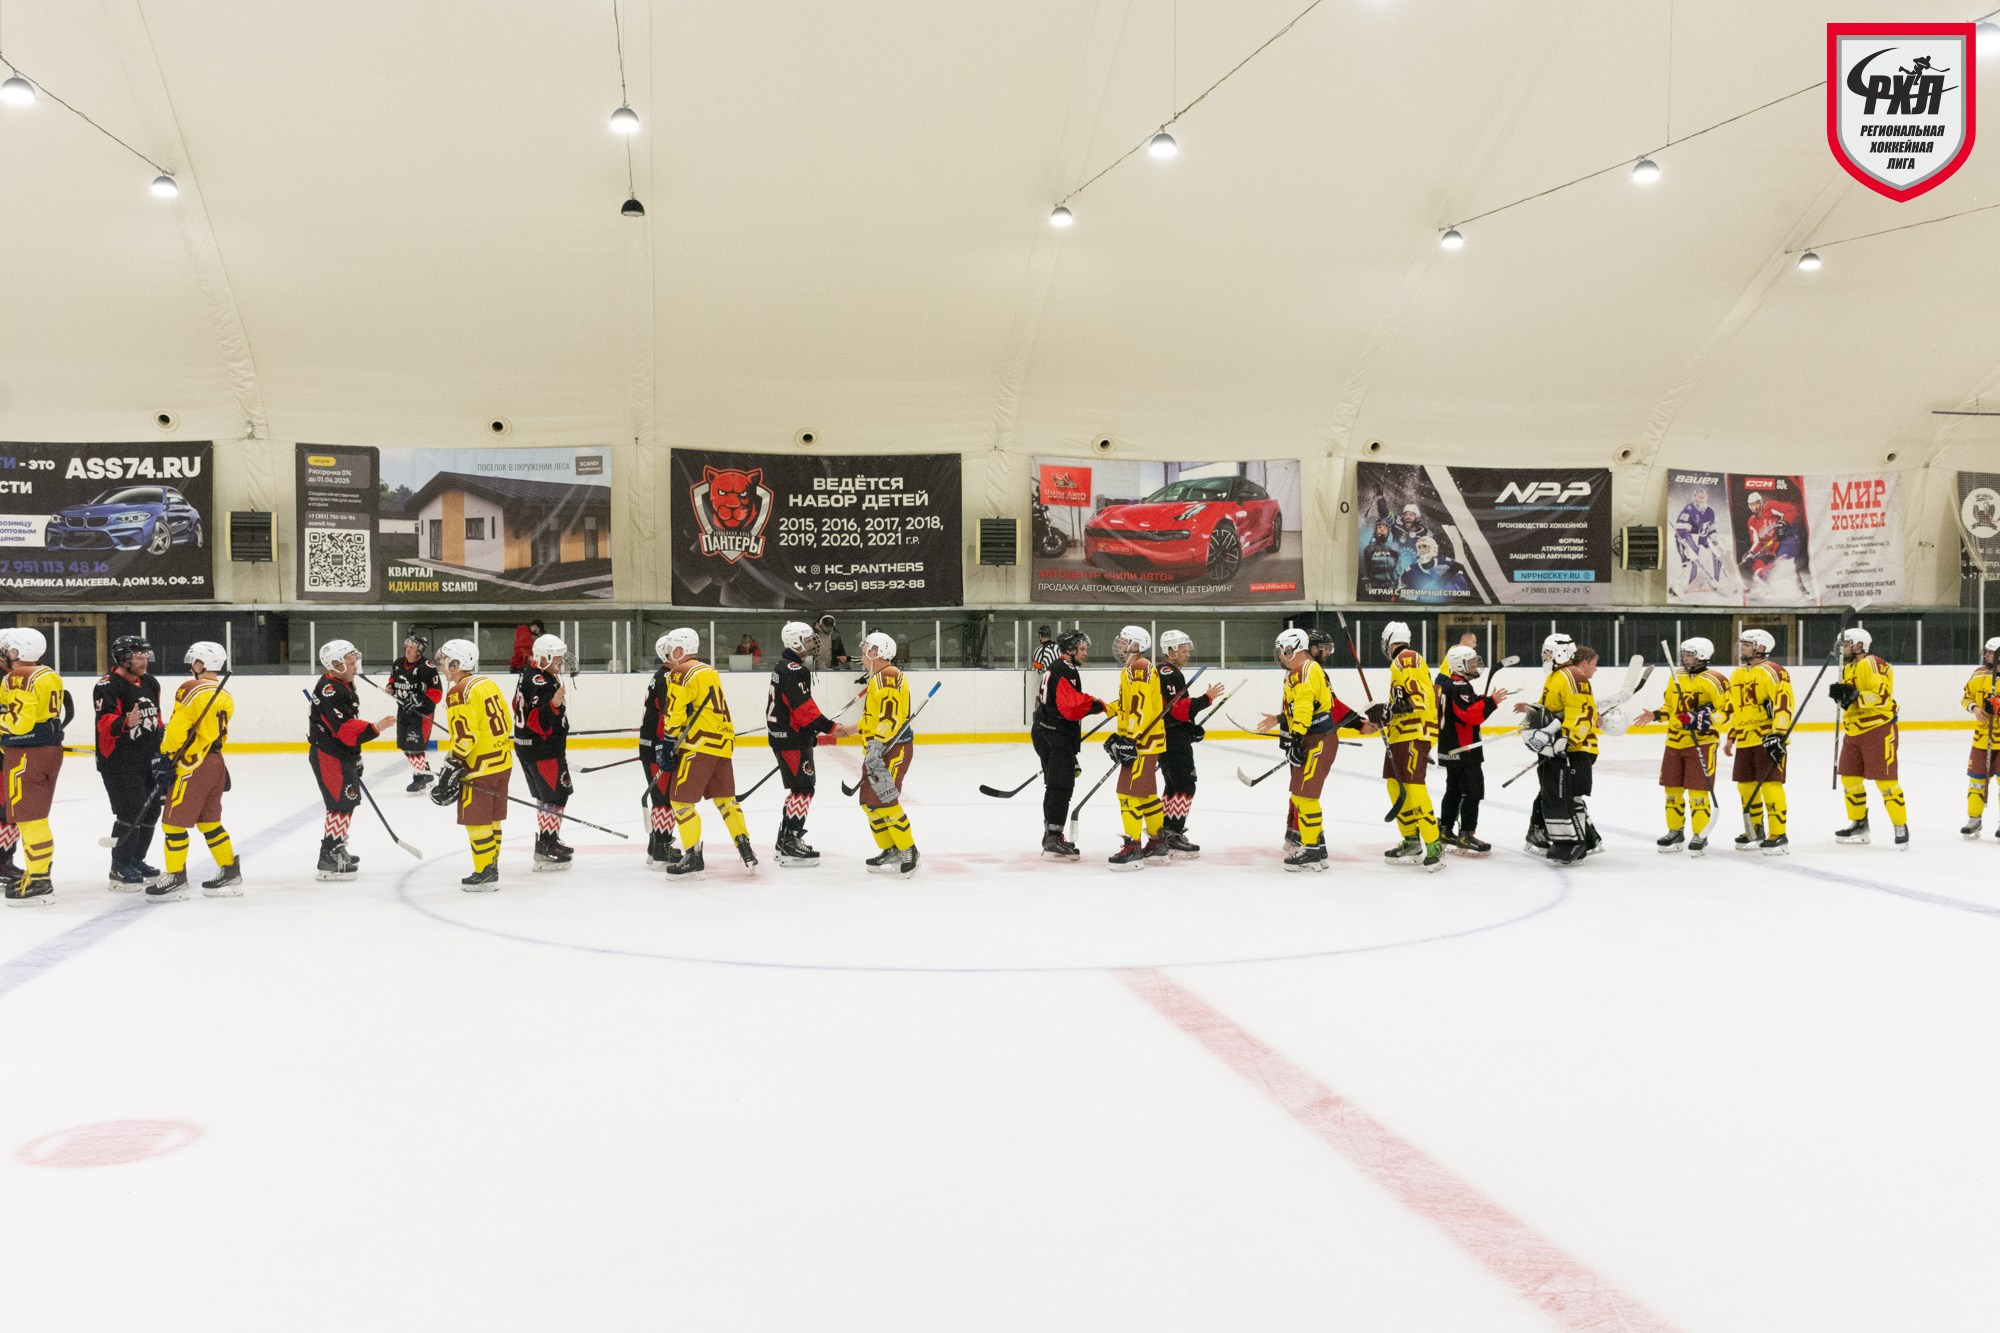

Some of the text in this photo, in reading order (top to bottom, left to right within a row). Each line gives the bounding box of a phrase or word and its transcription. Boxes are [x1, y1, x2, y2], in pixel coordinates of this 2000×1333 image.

[28, 459, 56, 471] это
[65, 456, 202, 480] ASS74.RU
[477, 462, 570, 472] ПОСЕЛОК В ОКРУЖЕНИИ ЛЕСА
[308, 468, 341, 476] Рассрочка
[316, 476, 350, 484] 01.04.2025
[813, 475, 904, 492] ВЕДЁТСЯ
[1494, 481, 1592, 503] NPP
[1831, 480, 1886, 511] МИР
[789, 490, 929, 510] НАБОР ДЕТЕЙ
[779, 516, 944, 533] 2015, 2016, 2017, 2018,
[1497, 521, 1588, 530] ПРОИЗВОДСТВО ХОККЕЙНОЙ
[702, 534, 763, 555] ПАНТЕРЫ
[779, 533, 817, 548] 2019,
[821, 533, 863, 548] 2020,
[867, 533, 902, 546] 2021
[13, 561, 40, 574] 951
[42, 561, 65, 573] 113
[68, 561, 90, 574] 48
[93, 561, 109, 573] 16
[388, 566, 434, 577] КВАРТАЛ
[825, 562, 924, 575] HC_PANTHERS
[1038, 569, 1101, 579] АВТОЦЕНТР
[1521, 572, 1580, 580] NPPHOCKEY.RU
[65, 578, 121, 587] МАКЕЕВА,
[122, 577, 150, 587] ДОМ
[151, 577, 168, 586] 36,
[168, 576, 190, 585] ОФ.
[191, 576, 205, 585] 25
[388, 581, 478, 593] ИДИЛЛИЯ SCANDI
[807, 582, 822, 591] +7
[861, 580, 925, 590] 853-92-88
[1038, 583, 1080, 592] ПРОДАЖА
[1081, 583, 1142, 593] АВТОМОБИЛЕЙ
[1149, 585, 1180, 594] СЕРВИС
[1185, 584, 1234, 593] ДЕТЕЙЛИНГ
[1368, 587, 1393, 595] ИГРАЙ
[1400, 589, 1471, 597] ПРЕИМУЩЕСТВОМ!
